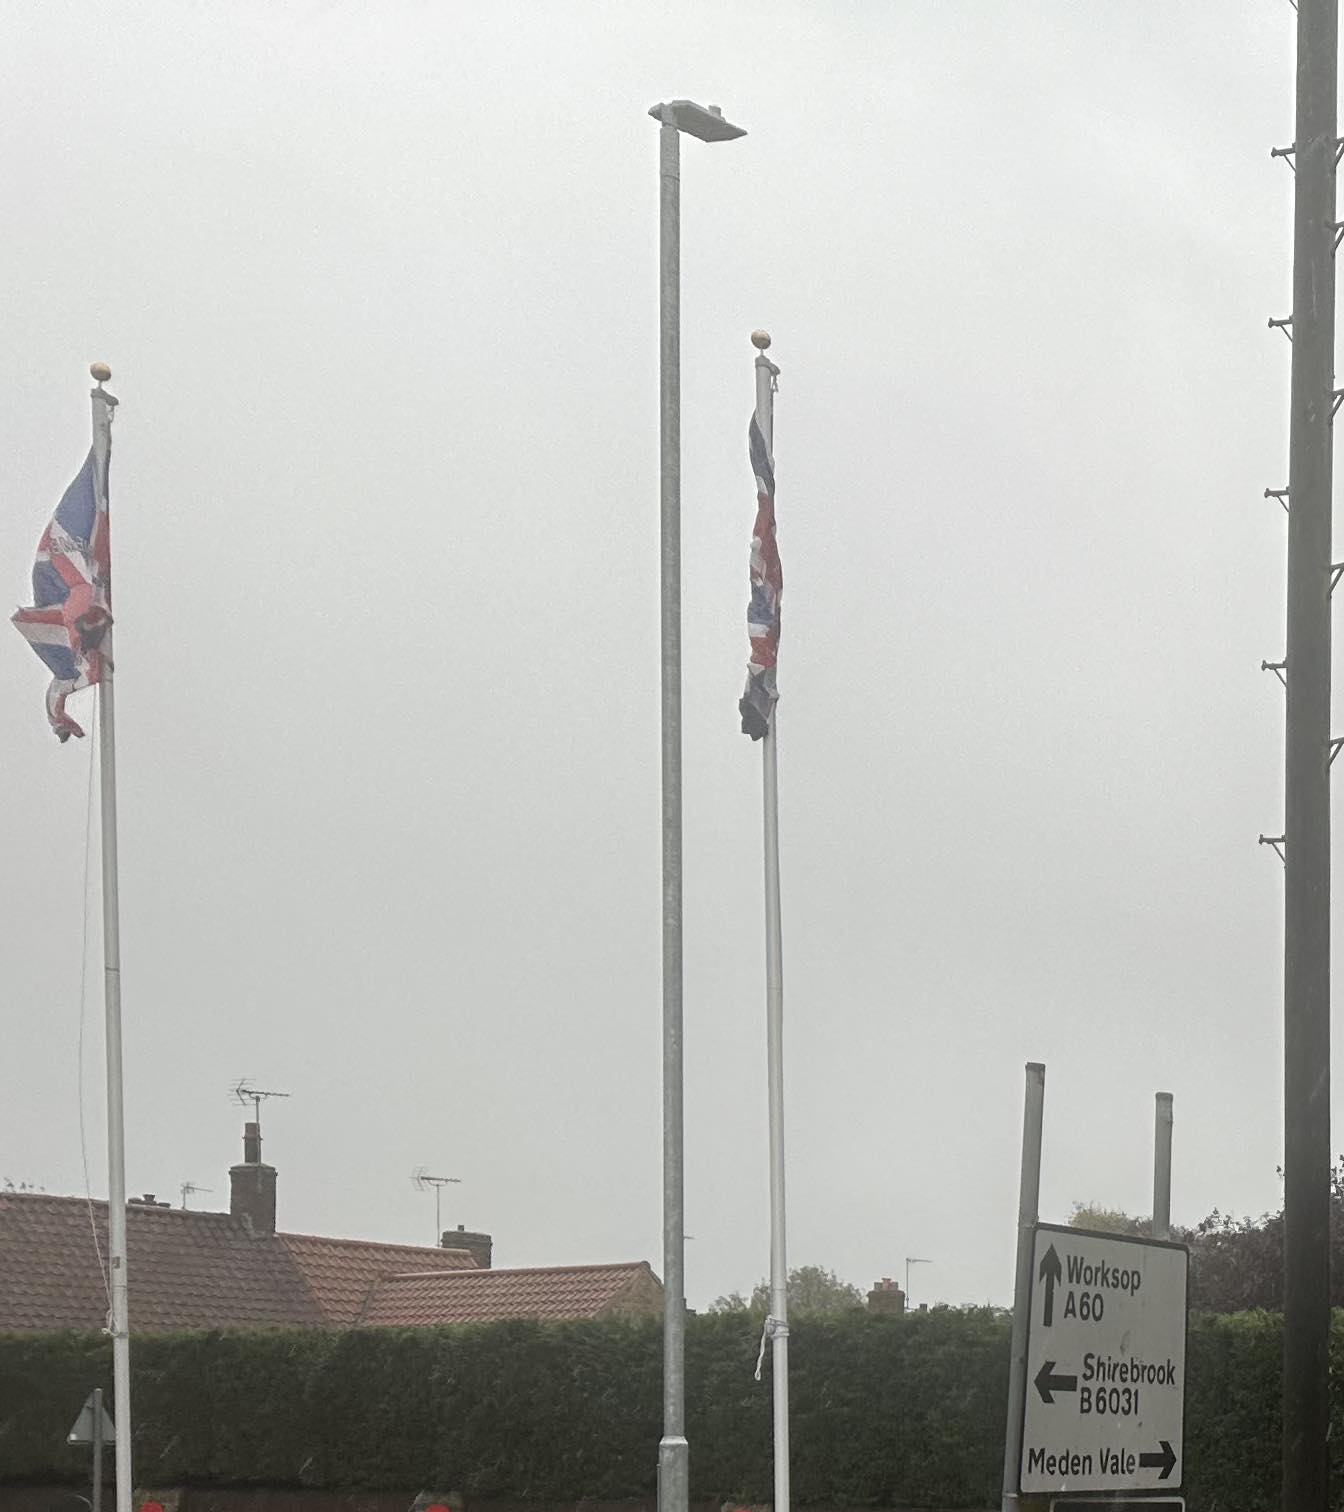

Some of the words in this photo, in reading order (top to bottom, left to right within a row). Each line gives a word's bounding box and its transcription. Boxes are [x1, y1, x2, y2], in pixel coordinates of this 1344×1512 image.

[1066, 1255, 1141, 1296] Worksop
[1063, 1291, 1104, 1322] A60
[1082, 1352, 1176, 1386] Shirebrook
[1080, 1387, 1139, 1416] B6031
[1028, 1447, 1093, 1476] Meden
[1099, 1447, 1136, 1475] Vale
